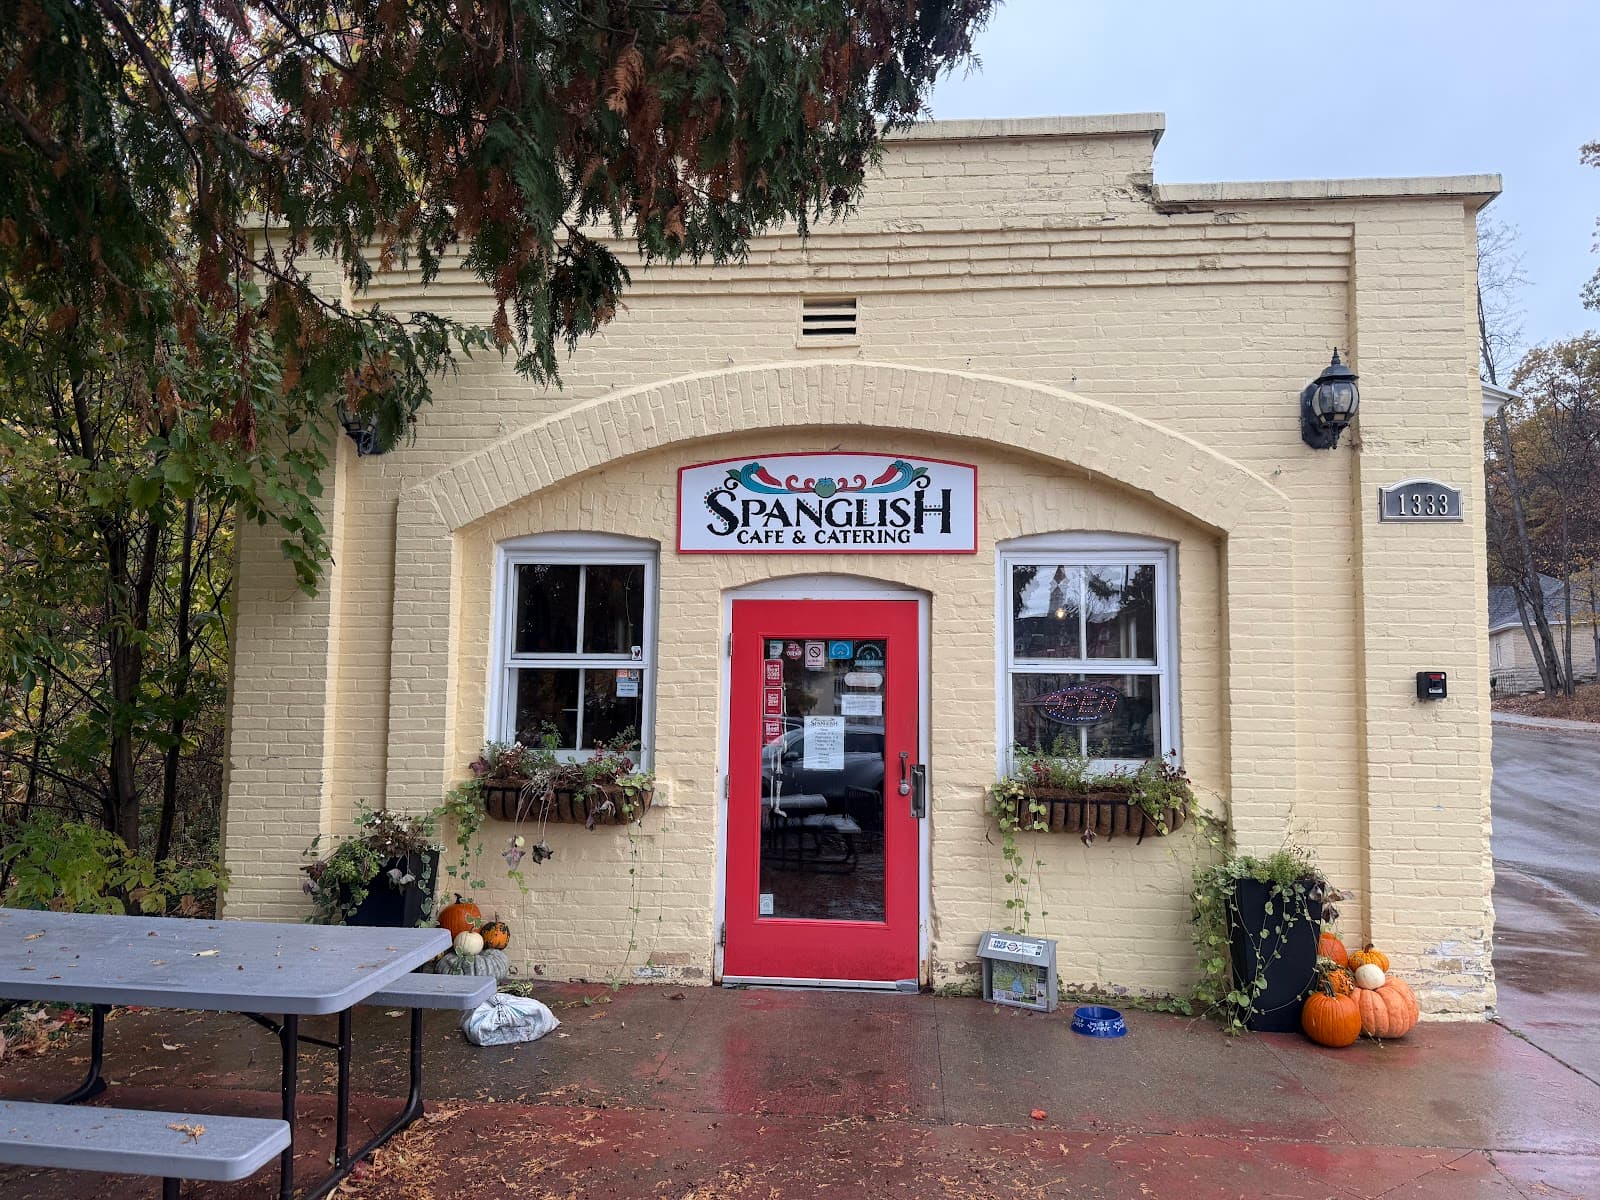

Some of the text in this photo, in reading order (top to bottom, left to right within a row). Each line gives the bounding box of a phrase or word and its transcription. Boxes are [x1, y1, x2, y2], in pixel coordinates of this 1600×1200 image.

[706, 488, 951, 536] SPANGLISH
[1399, 494, 1449, 516] 1333
[737, 529, 911, 544] CAFE & CATERING
[1045, 695, 1118, 713] OPEN
